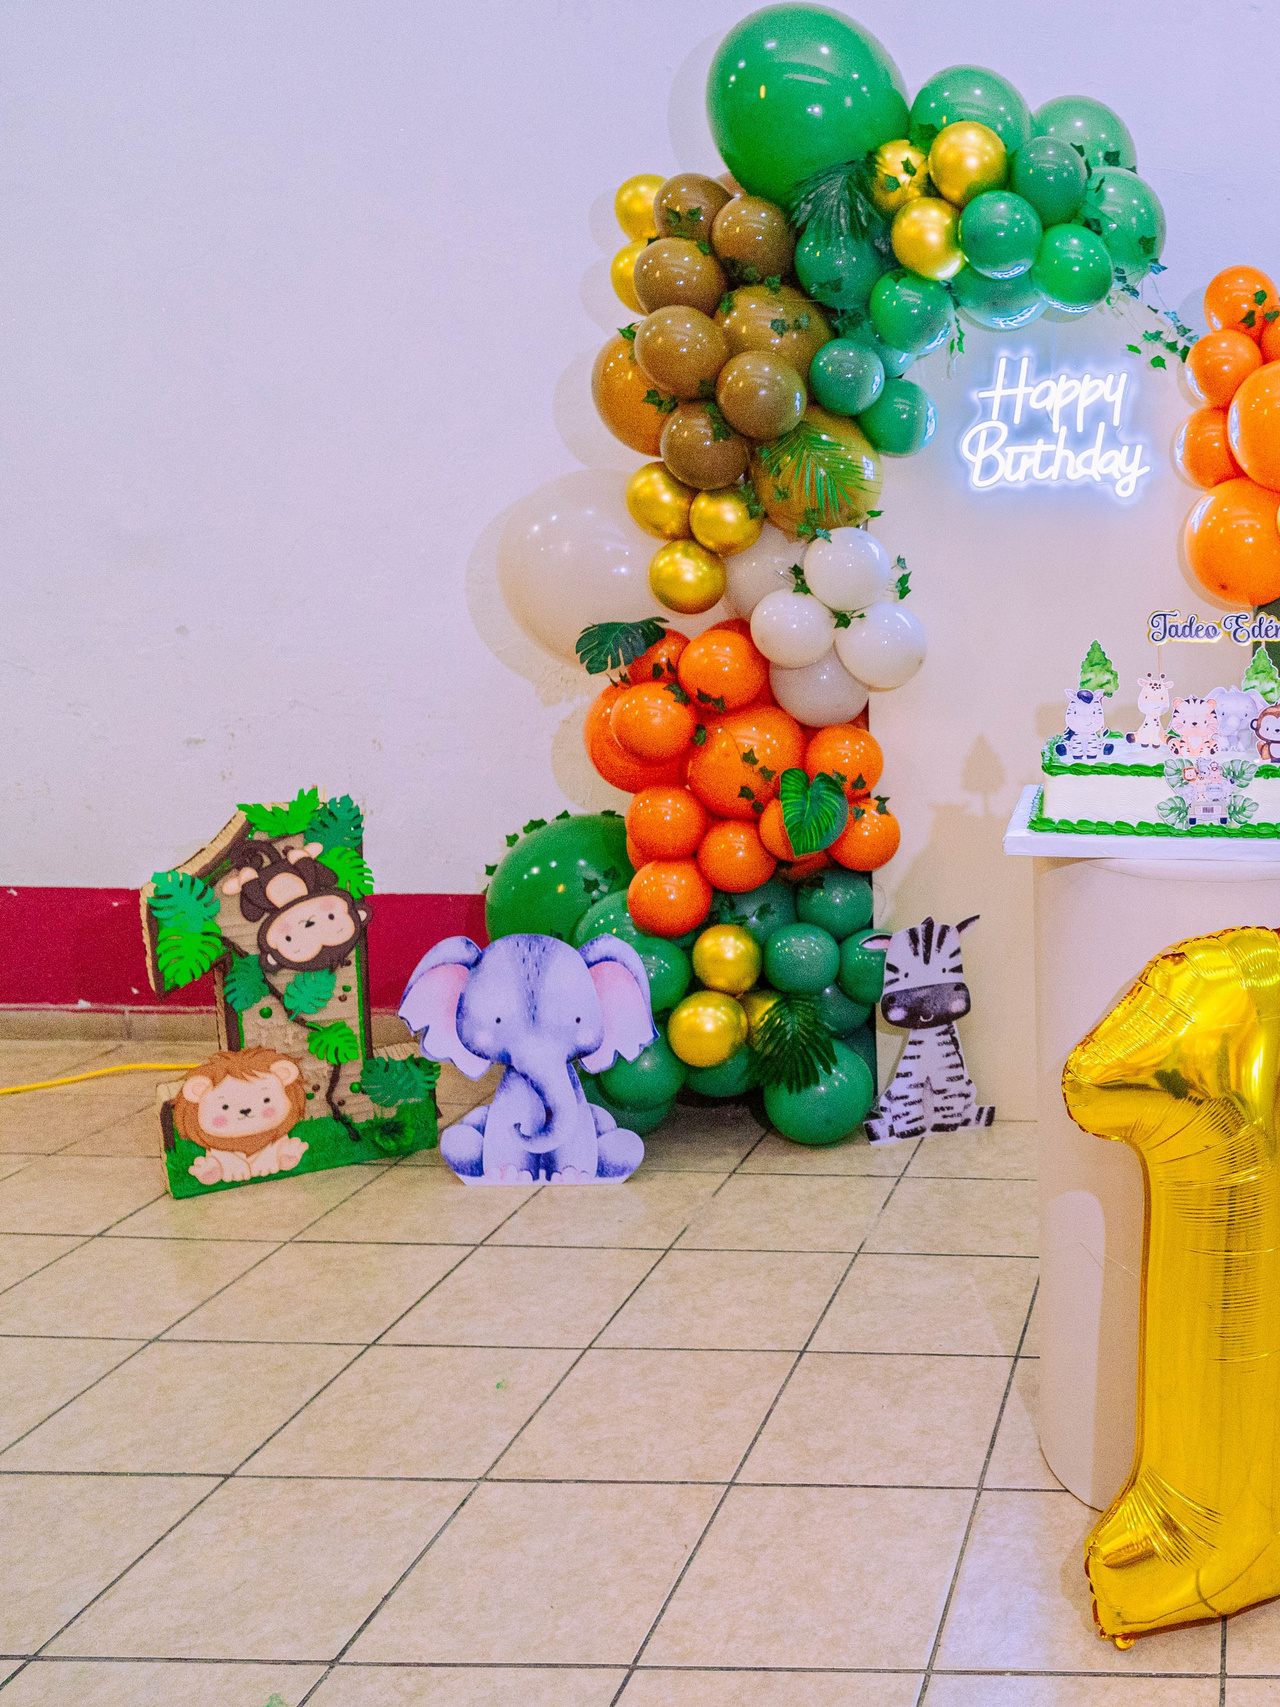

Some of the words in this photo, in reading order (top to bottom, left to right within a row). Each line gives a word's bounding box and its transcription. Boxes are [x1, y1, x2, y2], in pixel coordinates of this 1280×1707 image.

[978, 357, 1128, 433] Happy
[961, 420, 1151, 498] Birthday
[1150, 612, 1221, 642] Tadeo
